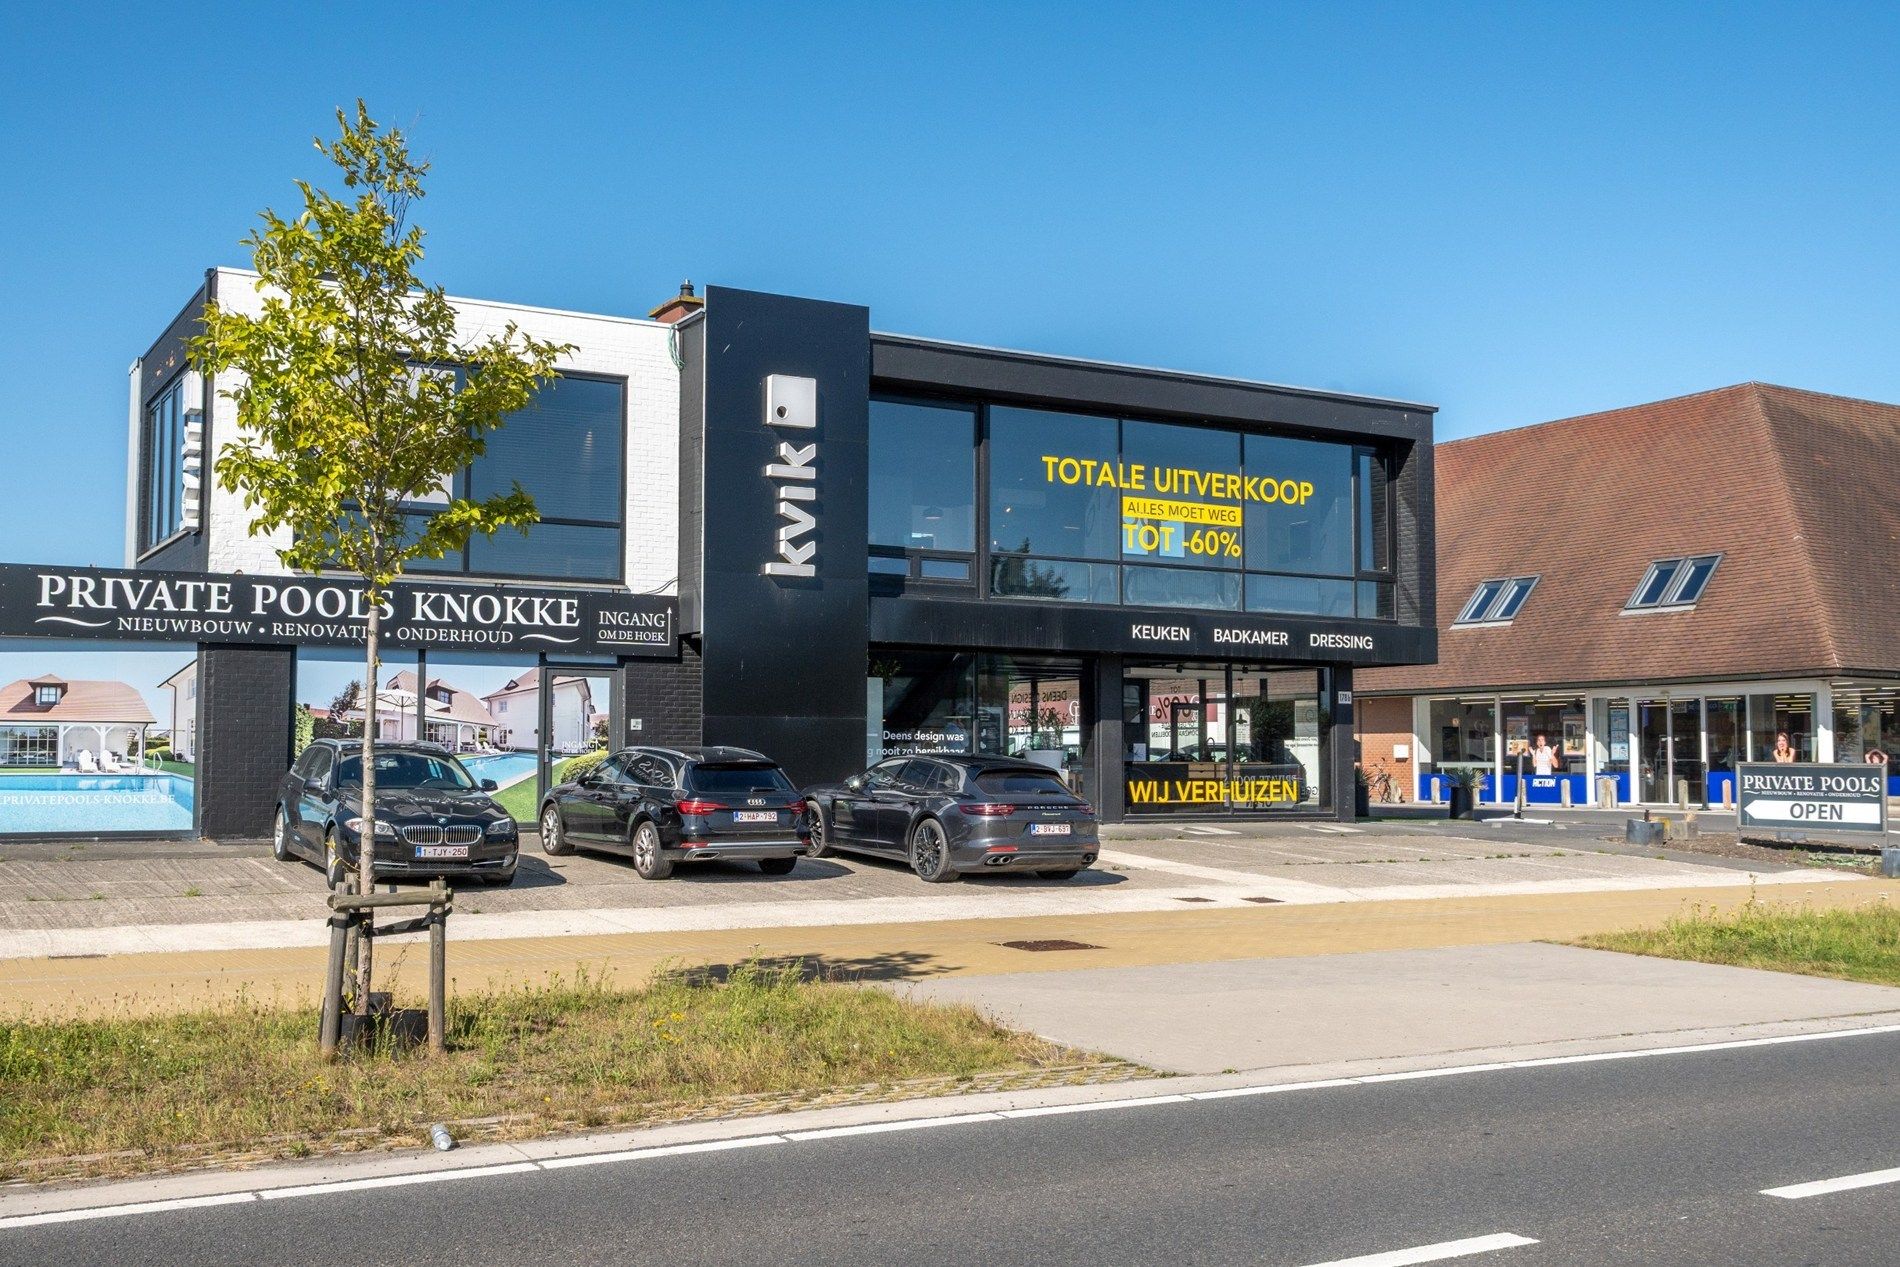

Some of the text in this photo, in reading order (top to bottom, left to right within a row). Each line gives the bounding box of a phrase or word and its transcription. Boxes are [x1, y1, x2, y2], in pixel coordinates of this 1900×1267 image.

[1041, 456, 1314, 506] TOTALE UITVERKOOP
[1127, 501, 1237, 523] ALLES MOET WEG
[1123, 523, 1242, 558] TOT -60%
[36, 574, 580, 627] PRIVATE POOLS KNOKKE
[598, 610, 666, 627] INGANG
[117, 617, 514, 644] NIEUWBOUW RENOVATI ONDERHOUD
[598, 629, 666, 642] OM DE HOEK
[1132, 624, 1373, 650] KEUKEN BADKAMER DRESSING
[883, 730, 965, 743] Deens design was
[876, 746, 901, 756] nooit
[1129, 780, 1168, 803] WIJ
[1175, 779, 1299, 803] VERHUIZEN
[1743, 775, 1880, 793] PRIVATE POOLS
[1789, 802, 1843, 820] OPEN
